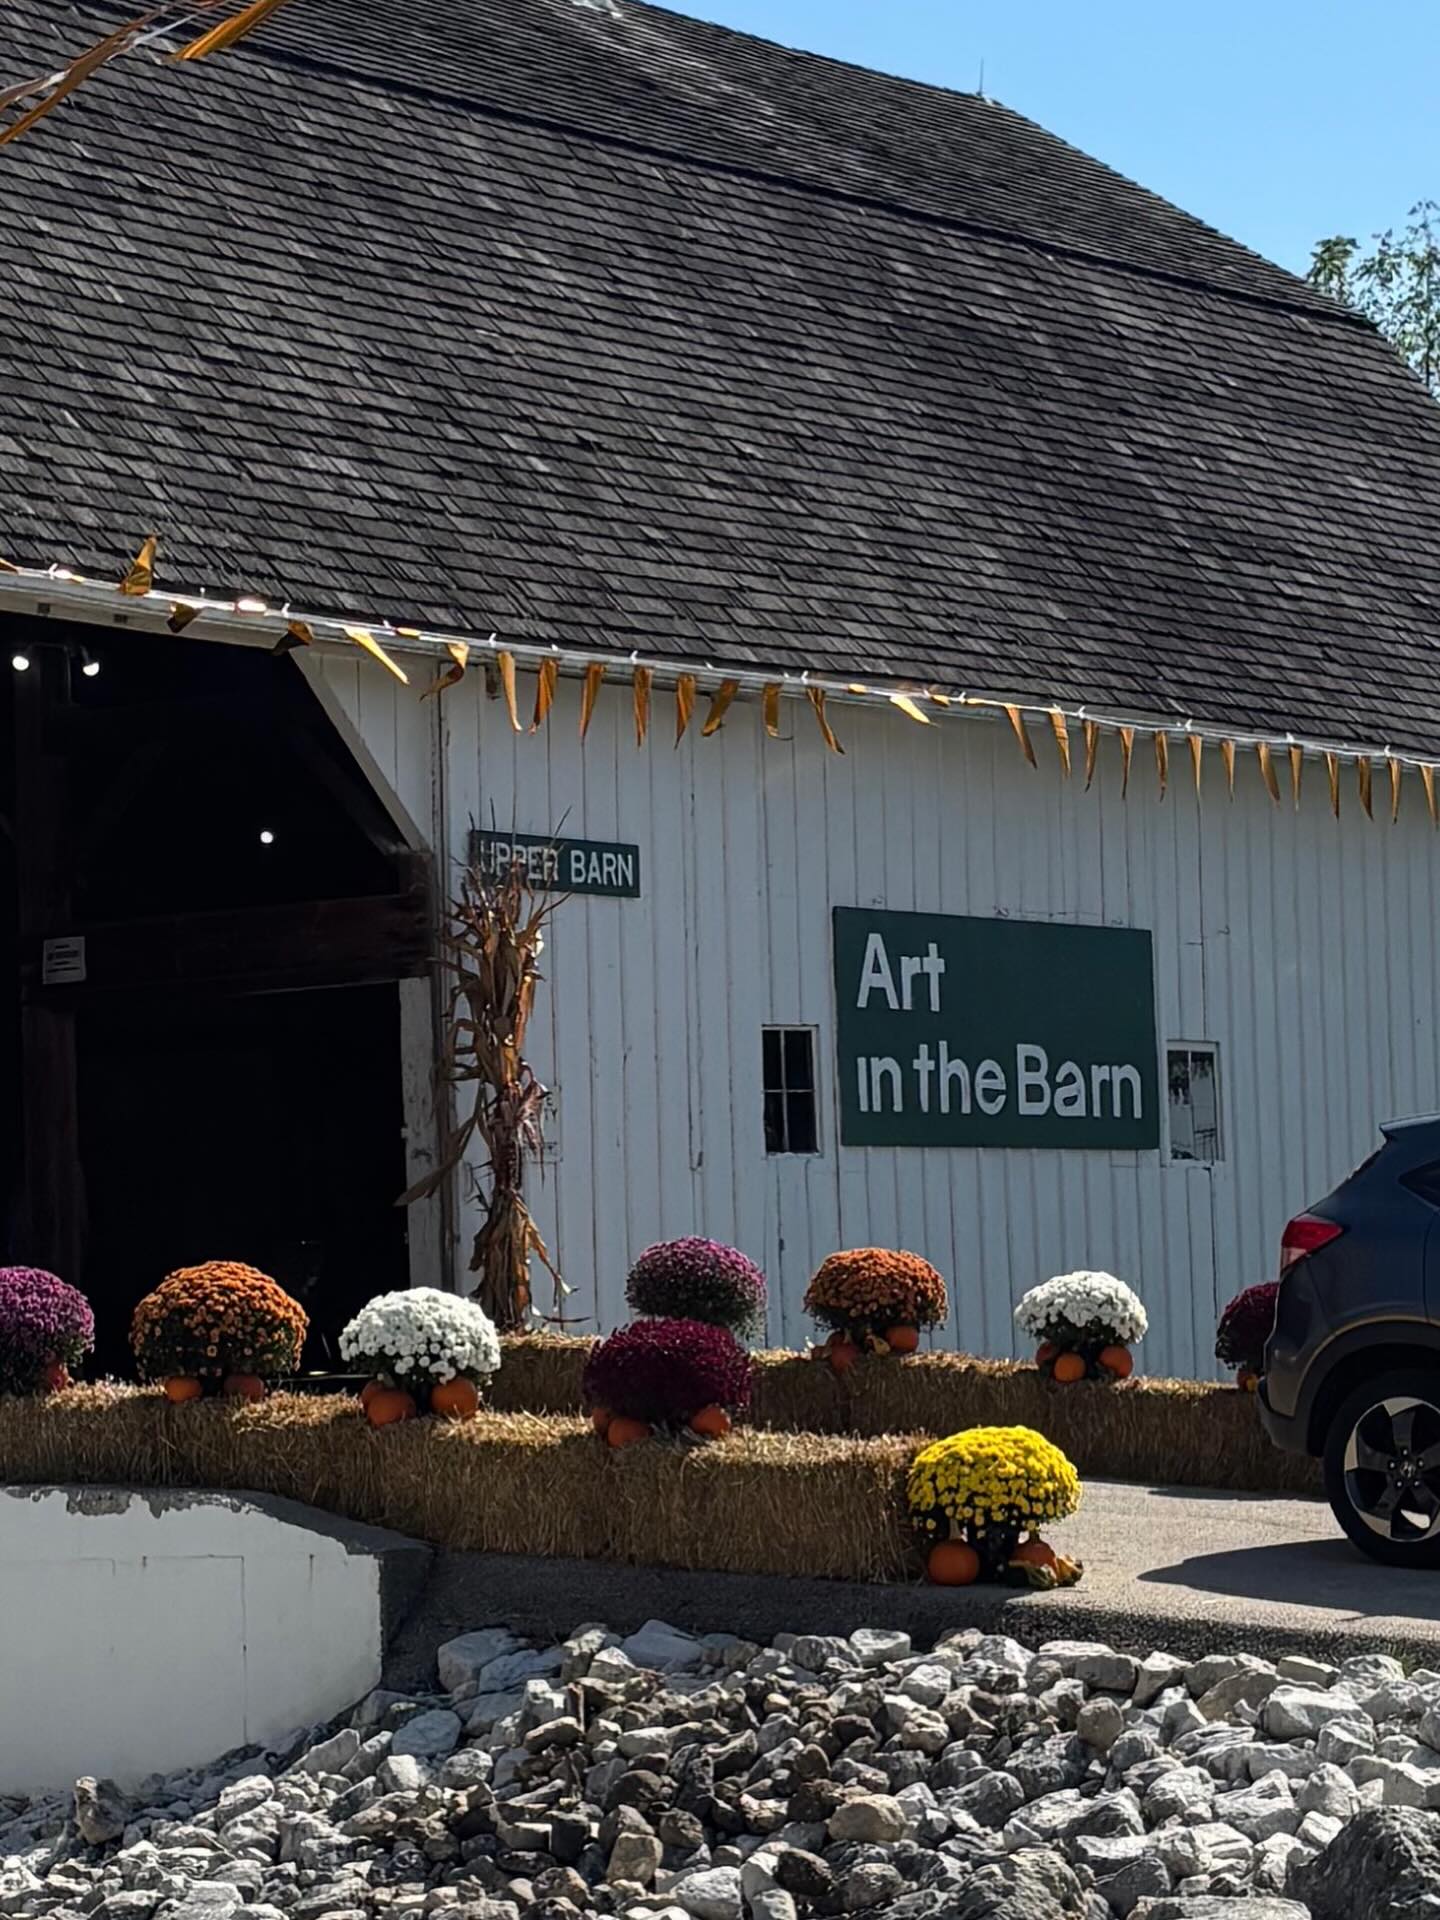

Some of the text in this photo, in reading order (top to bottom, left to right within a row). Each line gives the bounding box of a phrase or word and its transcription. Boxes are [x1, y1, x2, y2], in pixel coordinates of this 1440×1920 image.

[480, 839, 634, 887] UPPER BARN
[856, 932, 945, 1012] Art
[857, 1040, 1142, 1119] in the Barn
